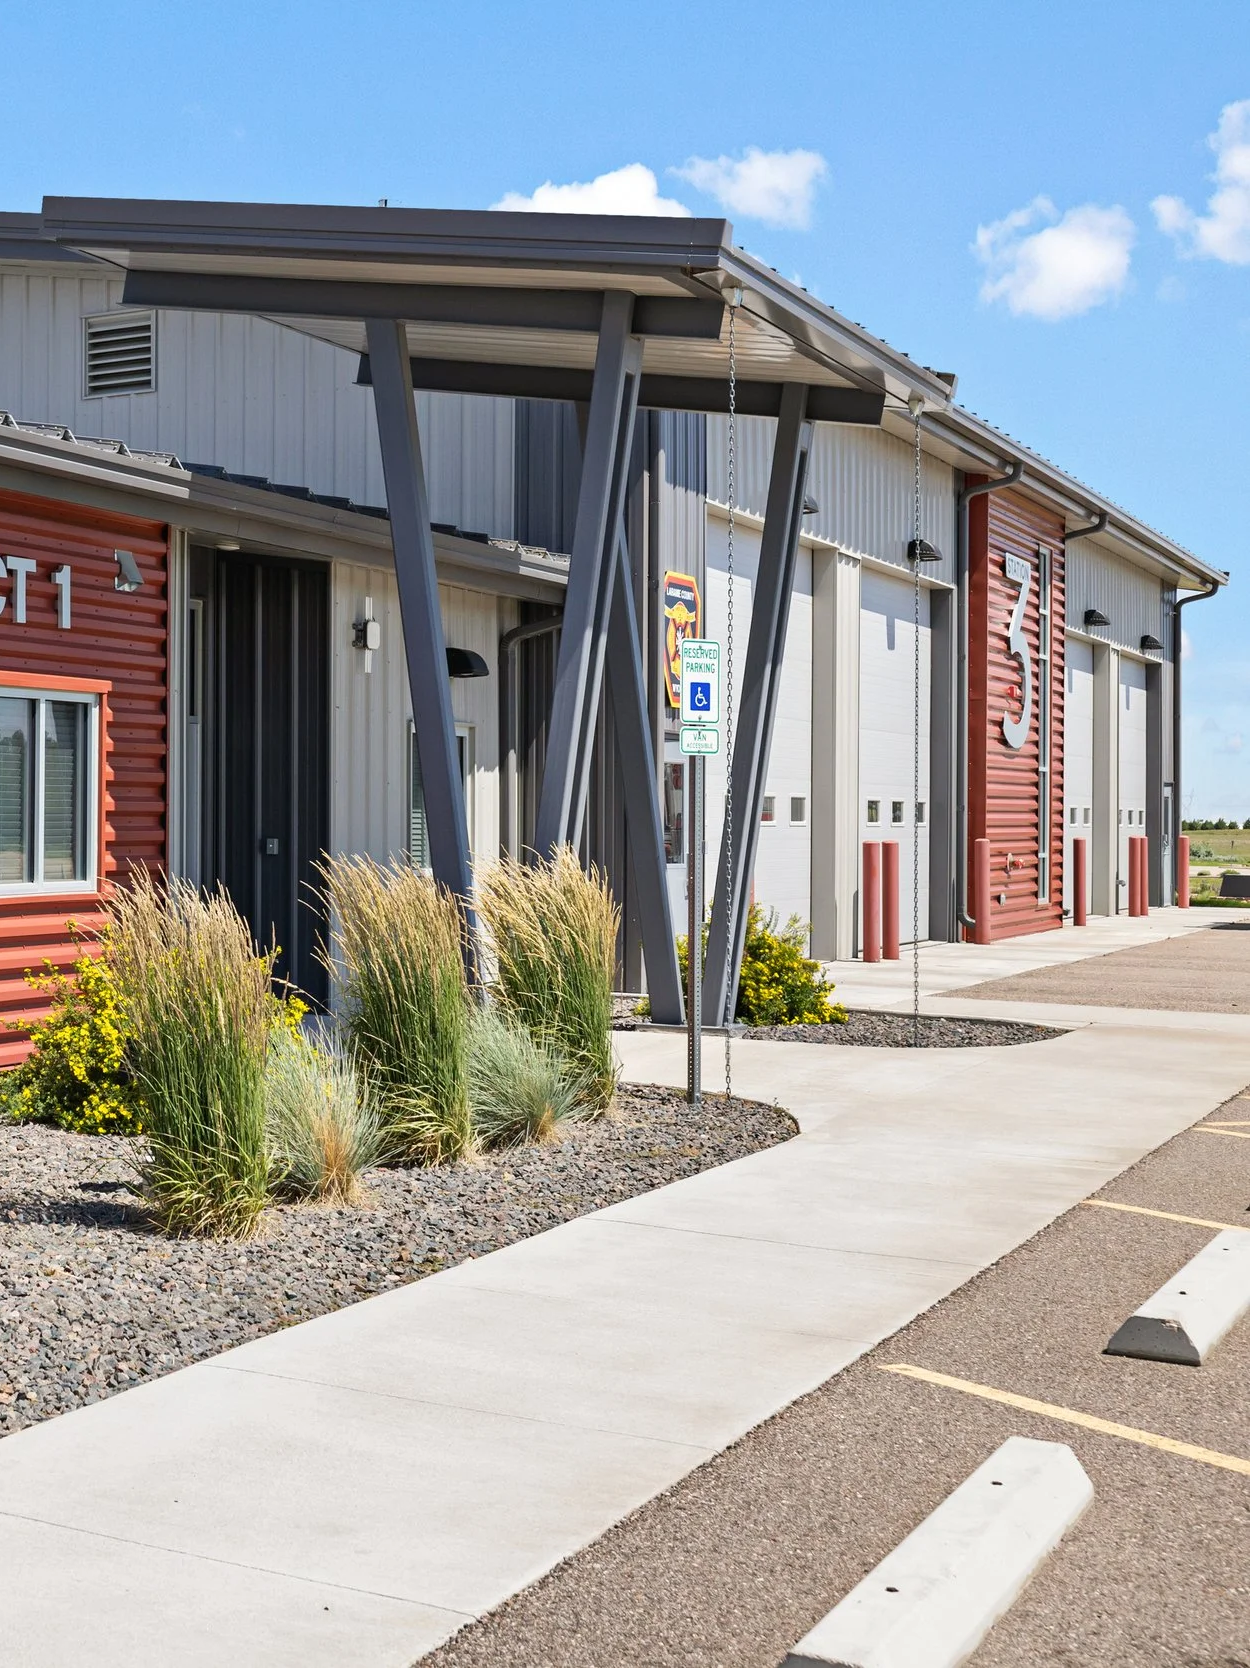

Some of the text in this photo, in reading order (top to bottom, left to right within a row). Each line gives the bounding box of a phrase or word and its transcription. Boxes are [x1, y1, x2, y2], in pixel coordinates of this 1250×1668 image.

[1006, 557, 1030, 582] STATION
[51, 564, 72, 629] 1
[683, 647, 718, 660] RESERVED
[1004, 553, 1033, 749] 3
[685, 662, 716, 674] PARKING
[692, 734, 707, 742] VAN
[686, 742, 714, 750] ACCESSIBLE
